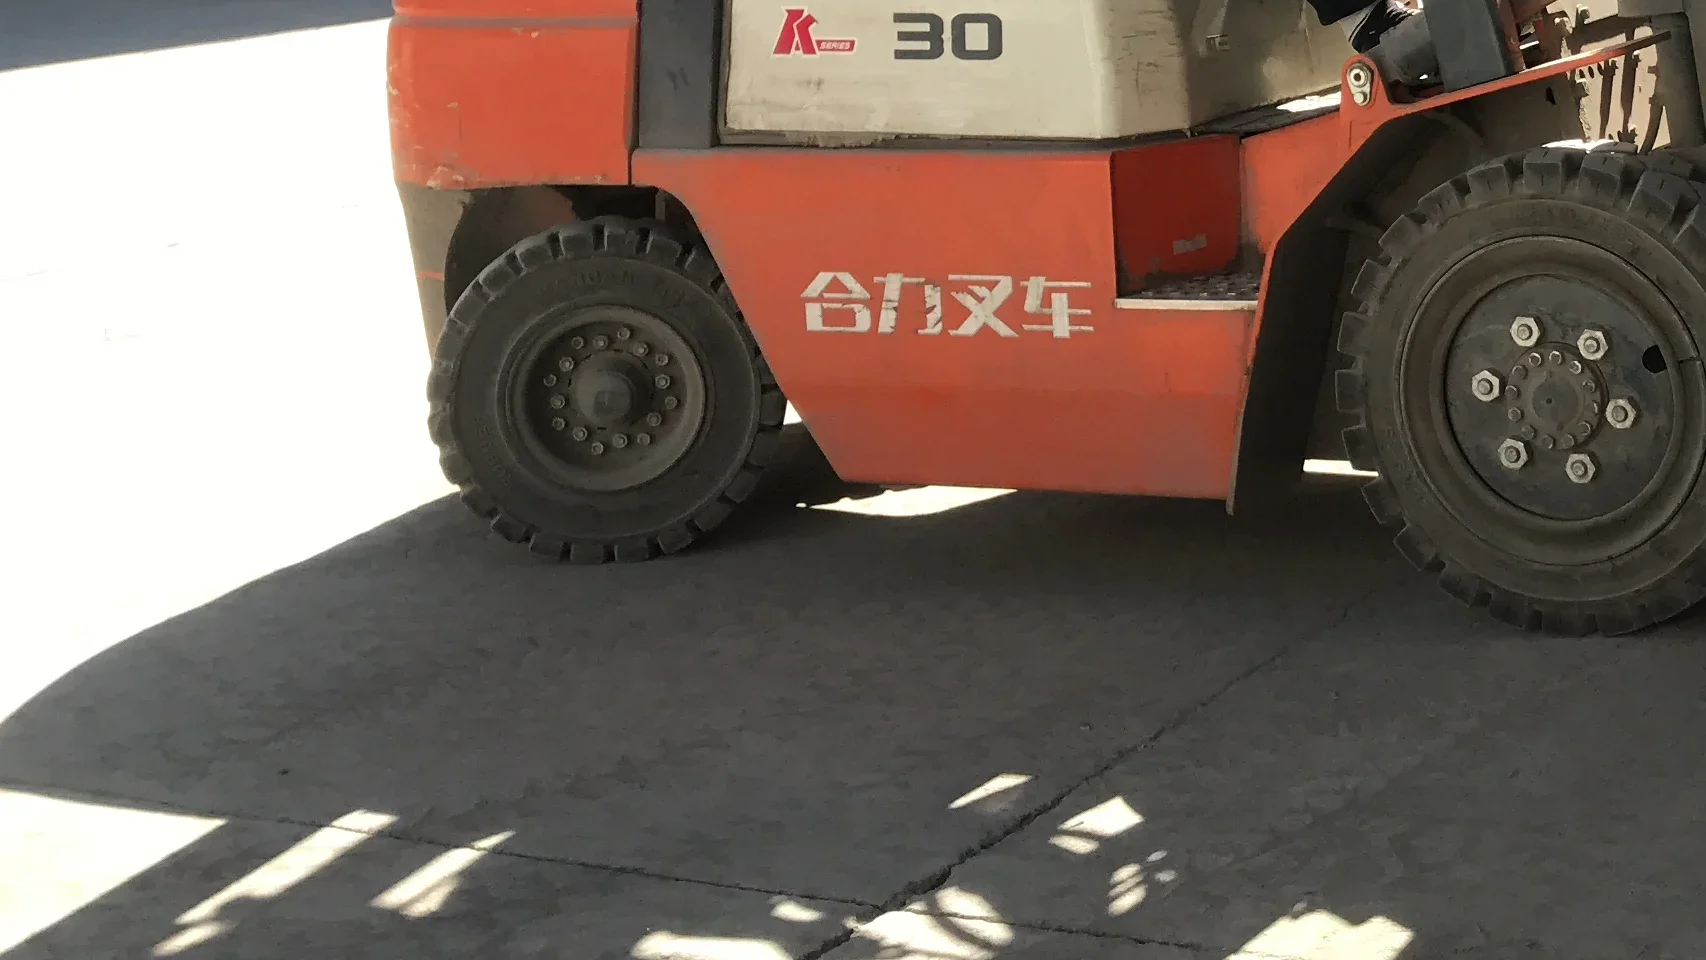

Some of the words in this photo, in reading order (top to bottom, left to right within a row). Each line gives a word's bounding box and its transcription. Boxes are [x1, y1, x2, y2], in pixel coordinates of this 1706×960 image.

[773, 8, 819, 55] K
[819, 41, 851, 50] SERIES
[893, 12, 1003, 60] 30
[800, 271, 1095, 339] 合力叉车
